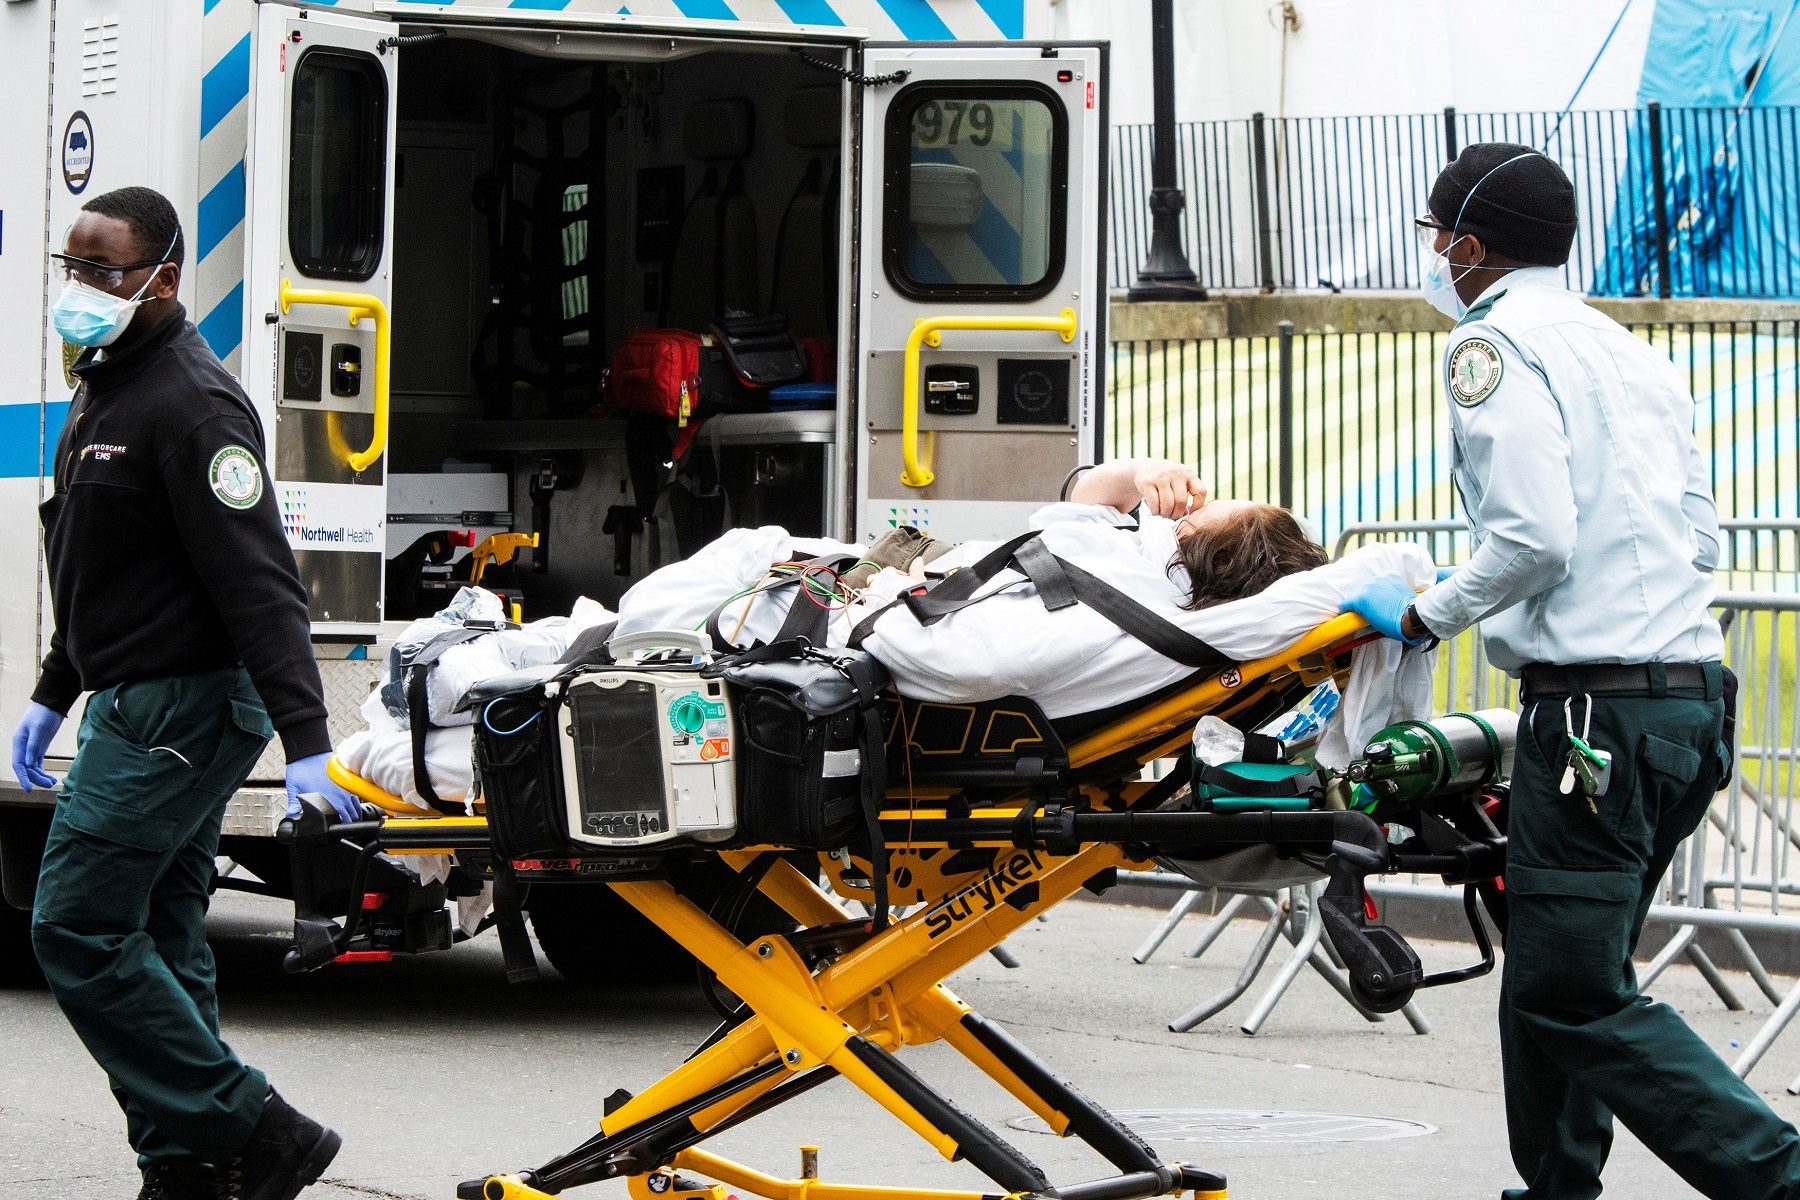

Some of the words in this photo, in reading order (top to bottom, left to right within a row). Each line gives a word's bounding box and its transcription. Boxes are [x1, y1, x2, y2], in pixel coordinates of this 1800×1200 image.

[913, 101, 994, 147] 979
[1452, 342, 1492, 369] SENIORCARE
[94, 451, 111, 461] EMS
[212, 449, 249, 473] SENIORCARE
[301, 526, 345, 542] Northwell
[347, 528, 374, 543] Health
[924, 848, 1047, 940] stryker
[374, 927, 402, 937] stryker
